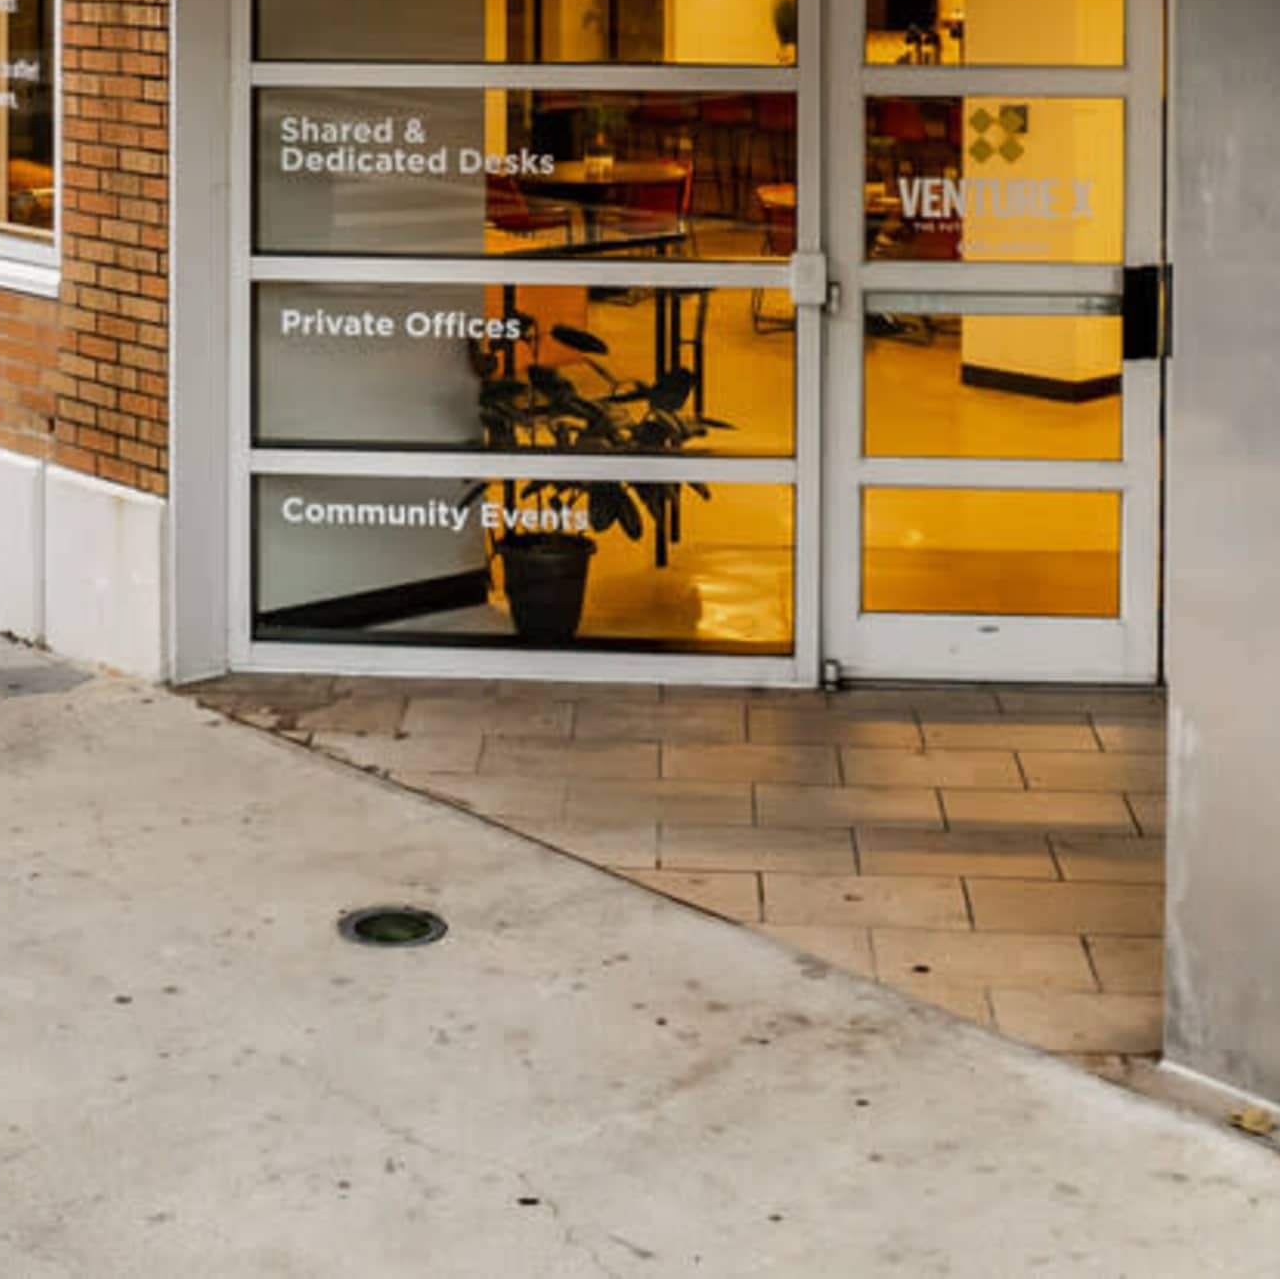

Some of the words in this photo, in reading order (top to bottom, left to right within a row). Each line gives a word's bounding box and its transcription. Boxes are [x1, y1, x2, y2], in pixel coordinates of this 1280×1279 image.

[280, 116, 394, 144] Shared
[403, 118, 427, 144] &
[280, 146, 448, 175] Dedicated
[459, 147, 556, 176] Desks
[898, 177, 1061, 219] VENTURE
[1072, 177, 1094, 220] X
[281, 309, 394, 338] Private
[406, 311, 521, 340] Offices
[281, 497, 469, 533] Community
[480, 503, 589, 533] Events
